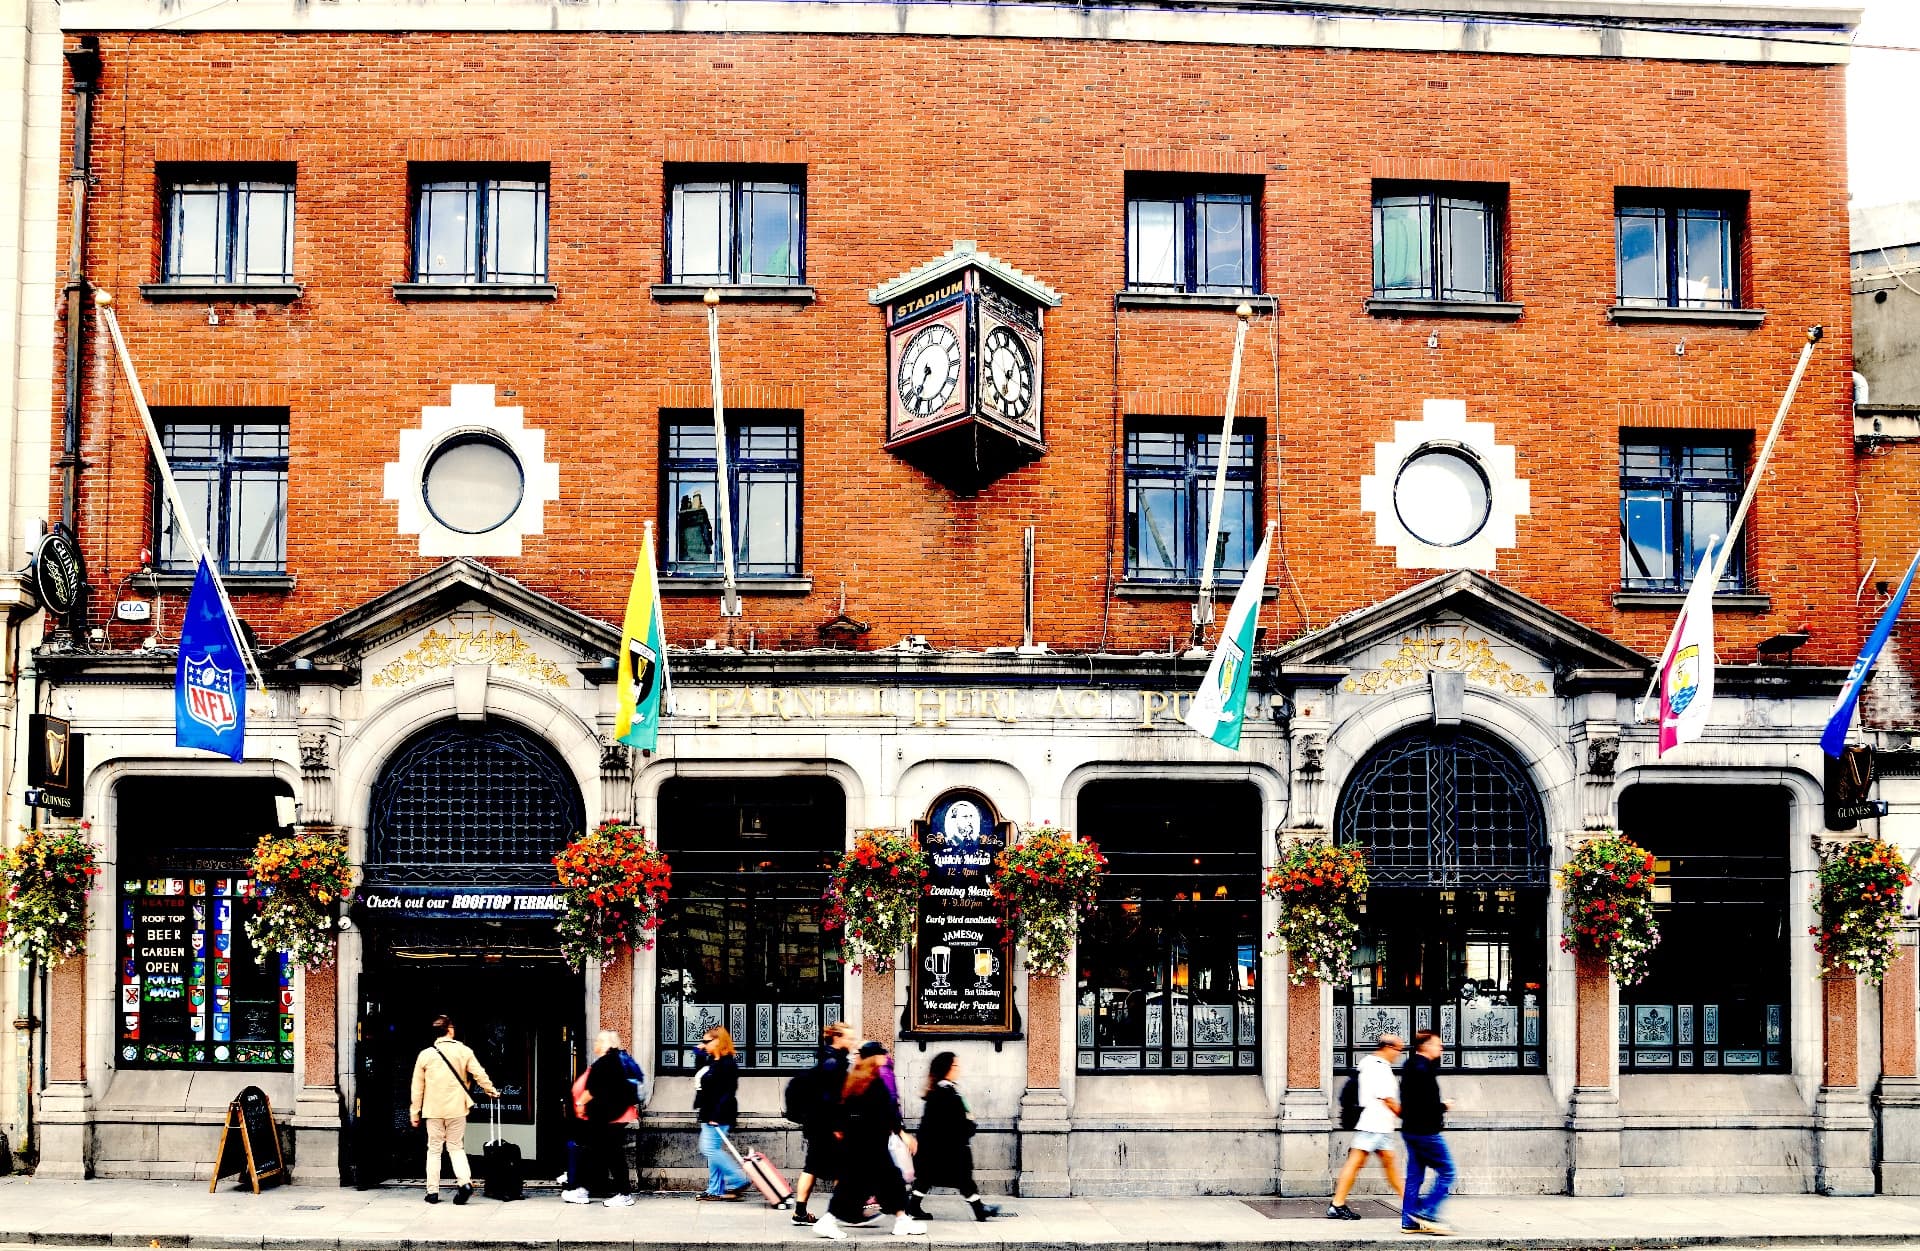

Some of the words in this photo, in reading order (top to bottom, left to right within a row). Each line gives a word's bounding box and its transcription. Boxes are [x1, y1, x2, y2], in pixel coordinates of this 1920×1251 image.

[897, 280, 963, 317] STADIUM
[120, 603, 145, 612] CIA
[458, 630, 488, 653] 74
[1431, 637, 1461, 660] 72
[191, 687, 233, 723] NFL
[703, 685, 897, 727] PARNELL
[1137, 690, 1199, 729] PU
[41, 792, 72, 807] GUINNESS
[1837, 806, 1871, 818] GUINNESS
[930, 885, 966, 899] Evening
[366, 895, 401, 909] Check
[405, 896, 424, 909] out
[427, 899, 449, 909] our
[452, 894, 512, 910] ROOFTOP
[141, 915, 166, 923] ROOF
[168, 915, 186, 923] TOP
[925, 914, 946, 926] Early
[147, 929, 181, 941] BEER
[942, 929, 984, 942] JAMESON
[141, 947, 185, 957] GARDEN
[145, 962, 179, 974] OPEN
[147, 976, 166, 985] FOR
[923, 1000, 938, 1010] We
